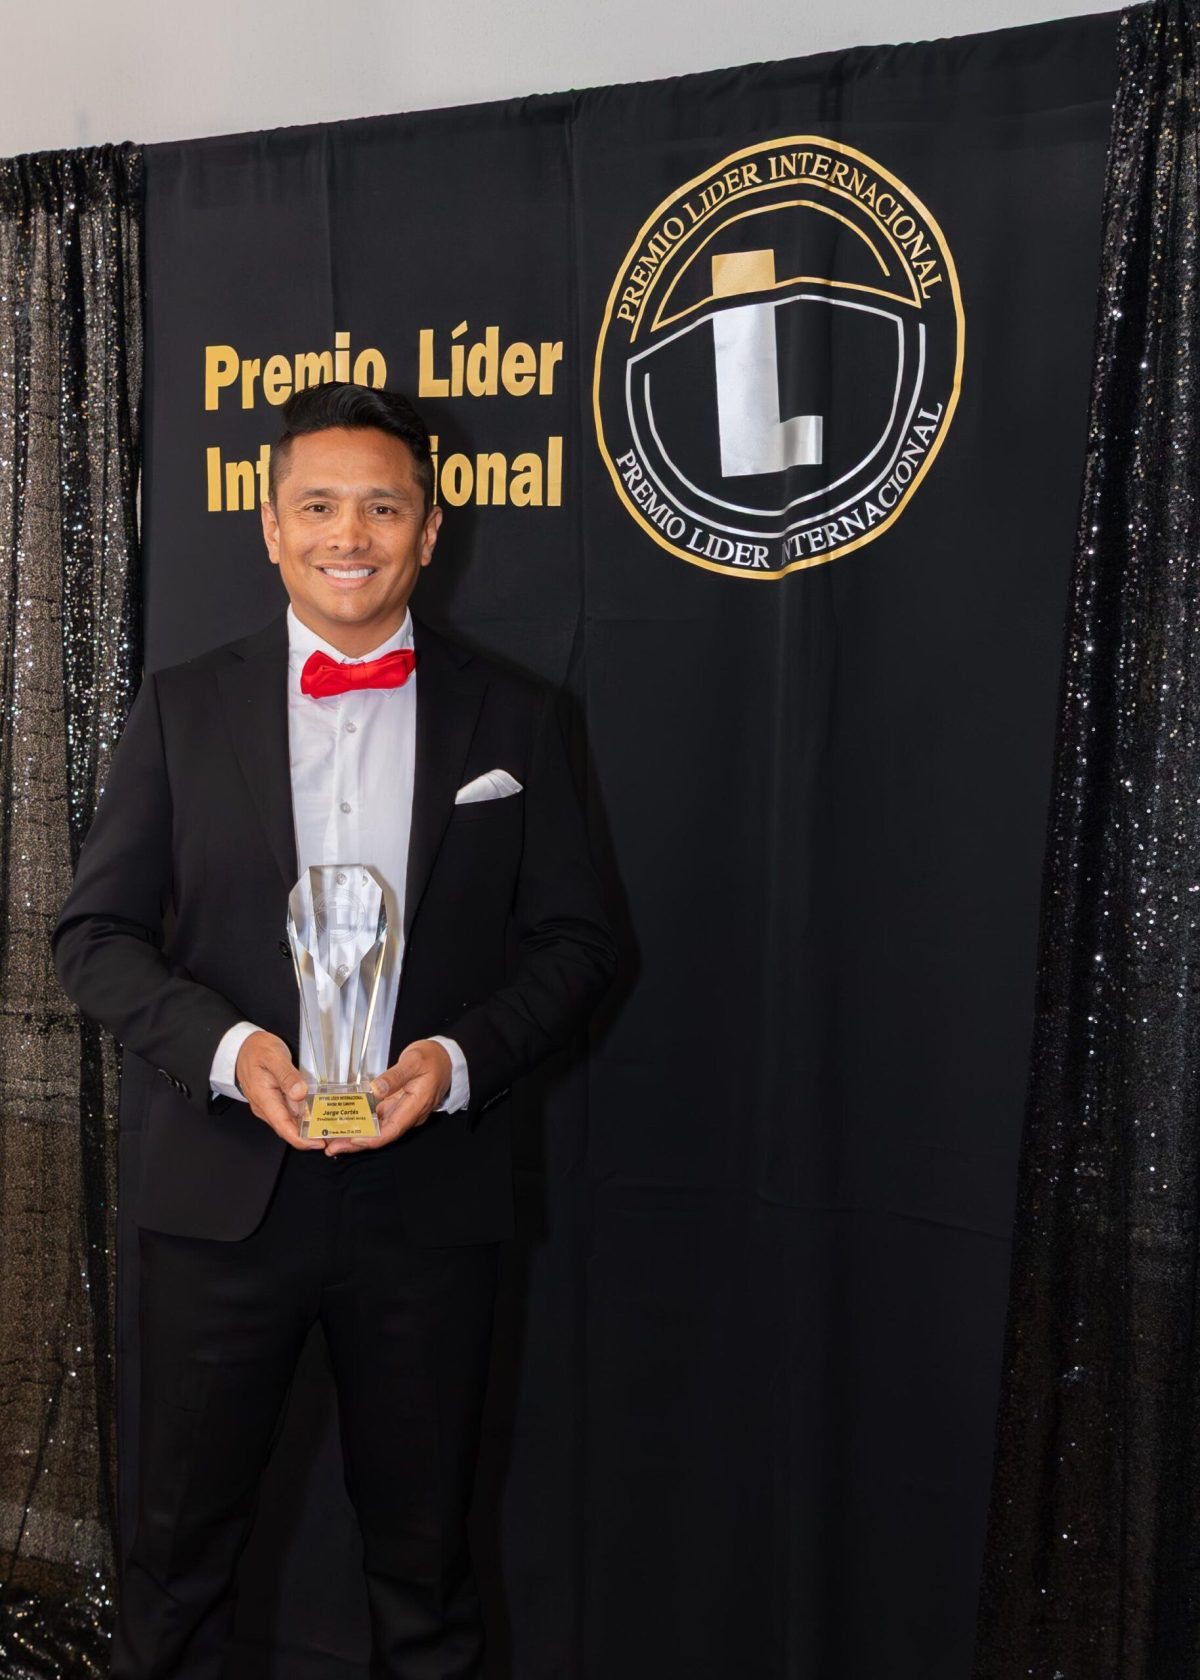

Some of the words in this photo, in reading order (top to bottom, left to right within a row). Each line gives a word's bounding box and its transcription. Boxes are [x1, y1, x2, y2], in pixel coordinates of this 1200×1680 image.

[617, 216, 685, 324] PREMIO
[682, 162, 762, 224] LIDER
[768, 152, 943, 300] INTERNACIONAL
[204, 331, 388, 410] Premio
[418, 319, 564, 398] Líder
[206, 436, 563, 513] Intional
[616, 449, 686, 540] PREMIO
[686, 528, 770, 569] LIDER
